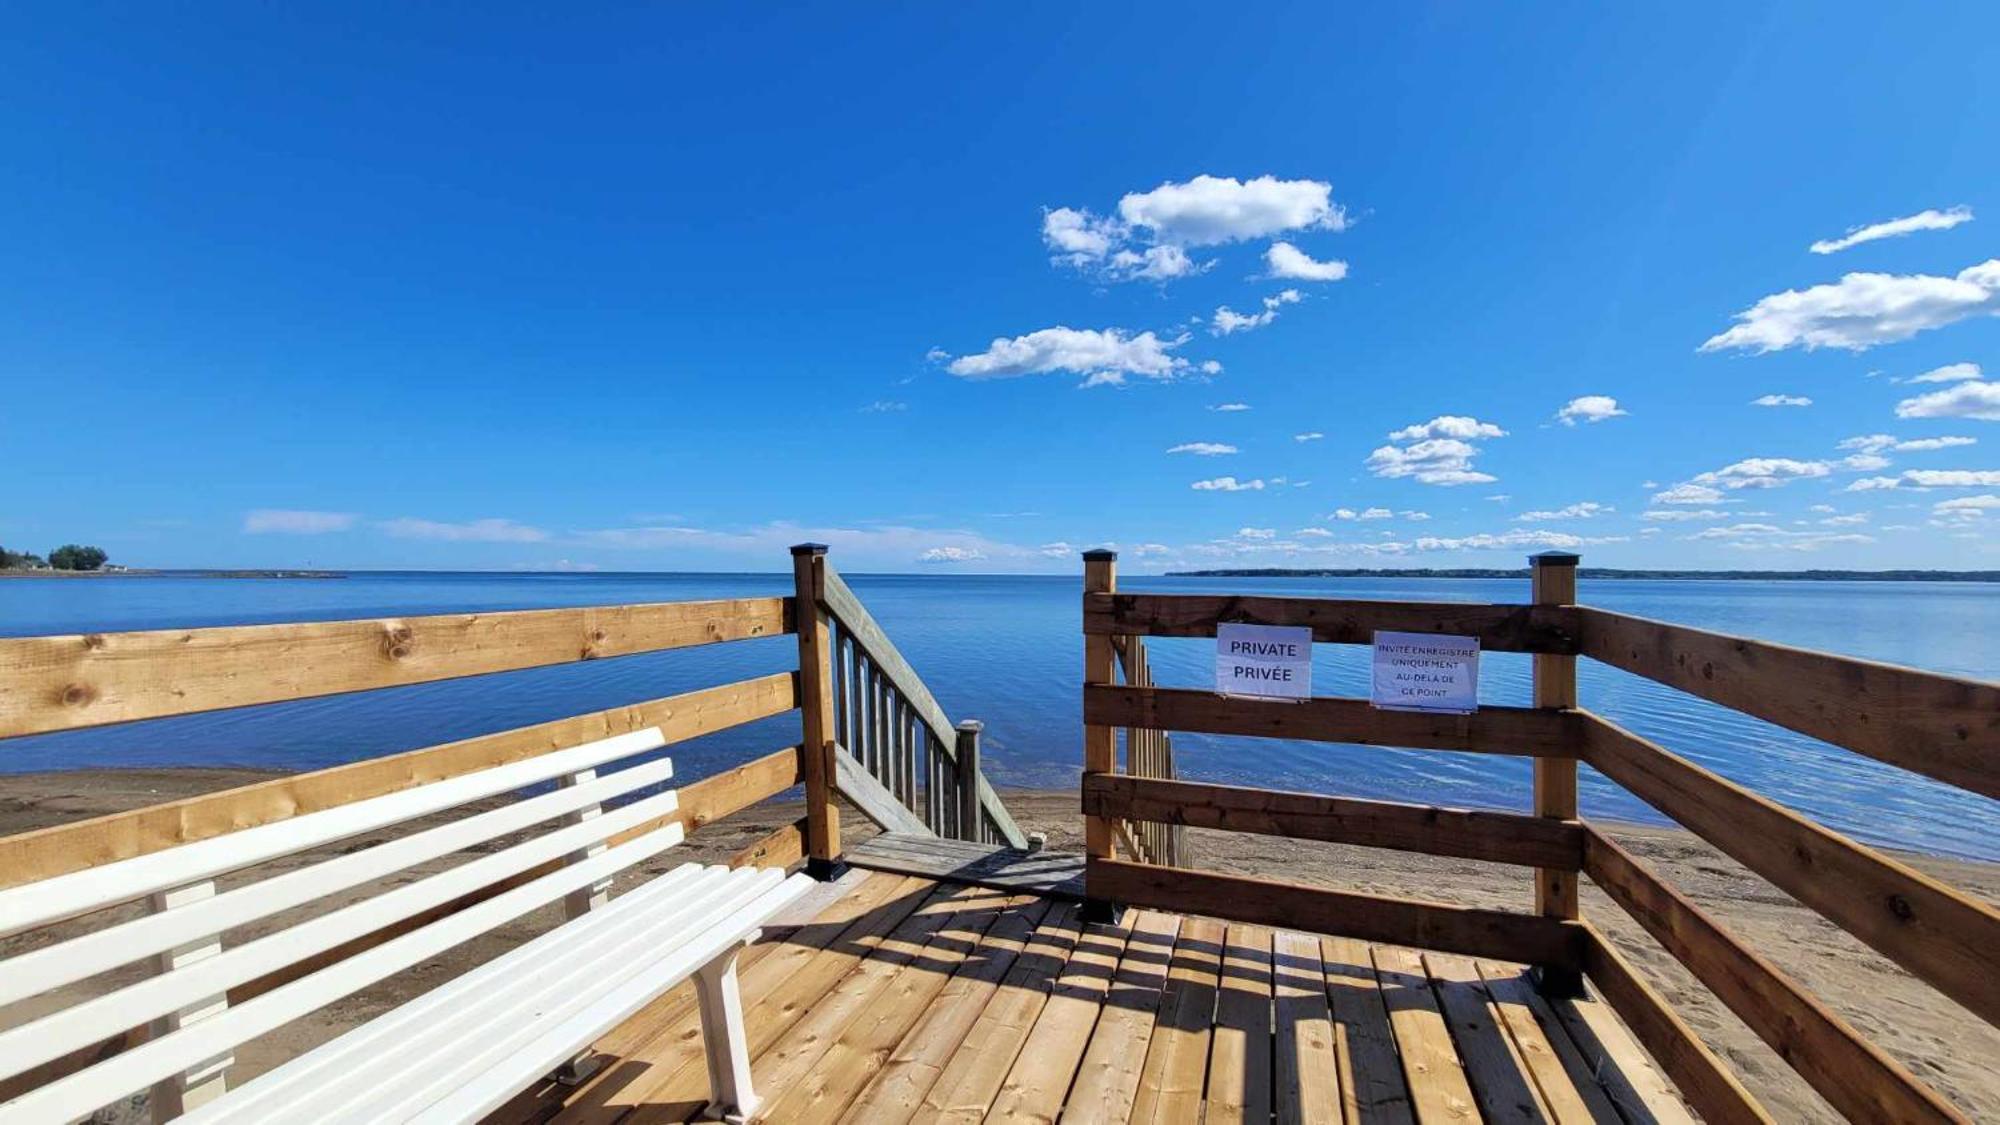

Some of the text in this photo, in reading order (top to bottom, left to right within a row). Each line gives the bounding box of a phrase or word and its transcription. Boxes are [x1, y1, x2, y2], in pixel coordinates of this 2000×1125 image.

[1230, 640, 1297, 657] PRIVATE
[1392, 659, 1459, 669] UNIQUEMENT
[1234, 665, 1292, 682] PRIVÉE
[1442, 675, 1455, 683] DE
[1416, 688, 1448, 697] POINT
